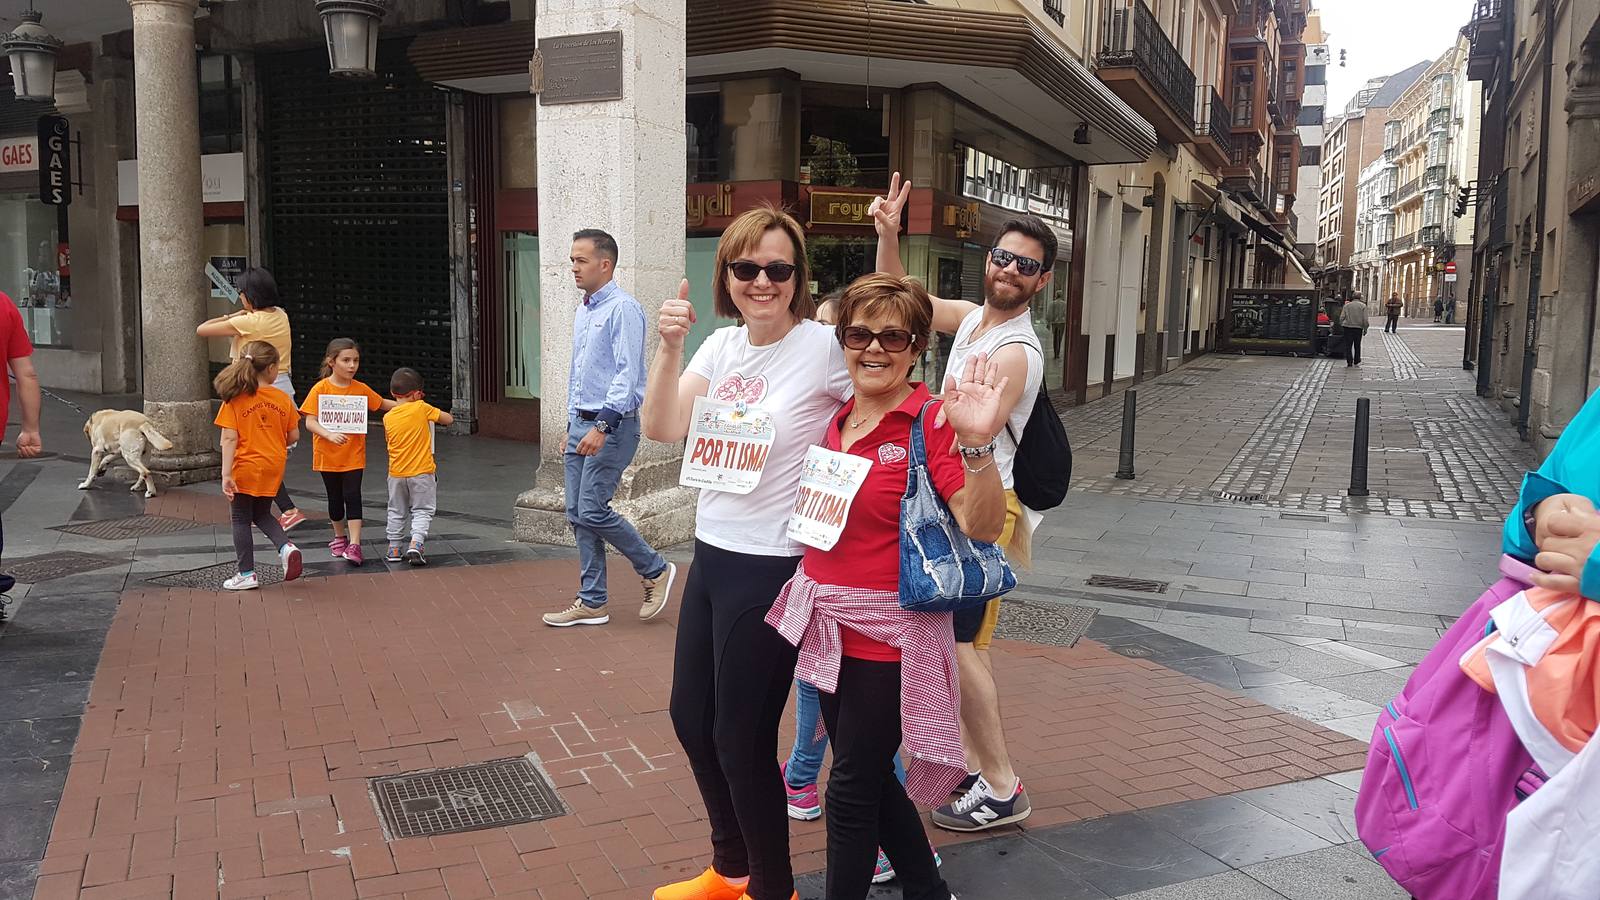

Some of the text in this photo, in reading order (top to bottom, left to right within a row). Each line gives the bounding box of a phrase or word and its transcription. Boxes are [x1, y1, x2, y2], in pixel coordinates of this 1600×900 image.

[2, 144, 32, 166] GAES
[48, 136, 63, 203] GAES
[687, 184, 731, 227] ydi
[263, 402, 286, 417] VERANO
[321, 411, 365, 425] TODO POR LAS TAPAS
[690, 437, 769, 472] POR TI ISMA
[805, 491, 823, 518] TI
[814, 493, 848, 528] ISMA
[970, 804, 999, 825] N
